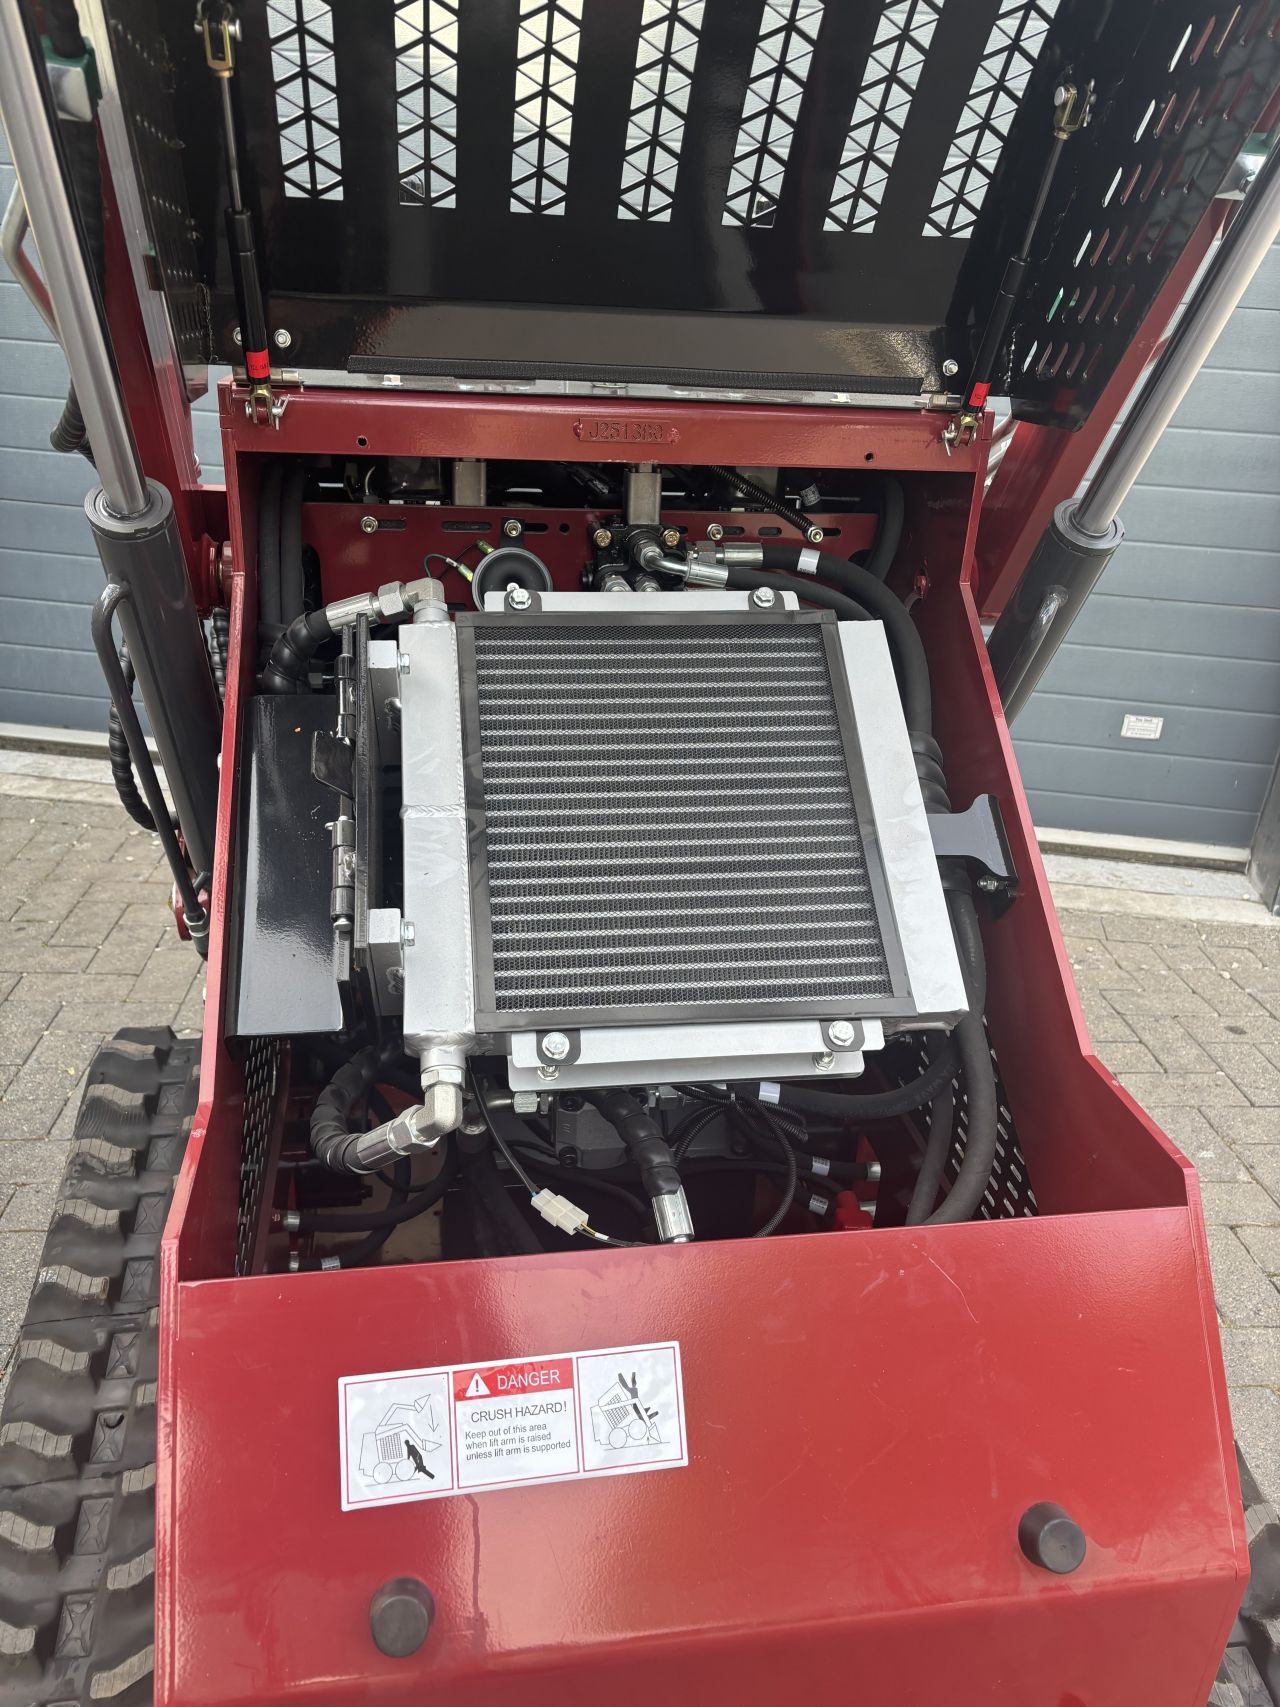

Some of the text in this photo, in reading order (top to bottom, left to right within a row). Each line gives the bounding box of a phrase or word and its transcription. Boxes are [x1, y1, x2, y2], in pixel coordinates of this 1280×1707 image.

[497, 1369, 560, 1390] DANGER
[471, 1401, 567, 1423] CRUSH HAZARD!
[465, 1423, 547, 1440] Keep out of this area
[465, 1432, 552, 1450] when lift arm is raised
[466, 1440, 571, 1461] unless lift arm is supported
